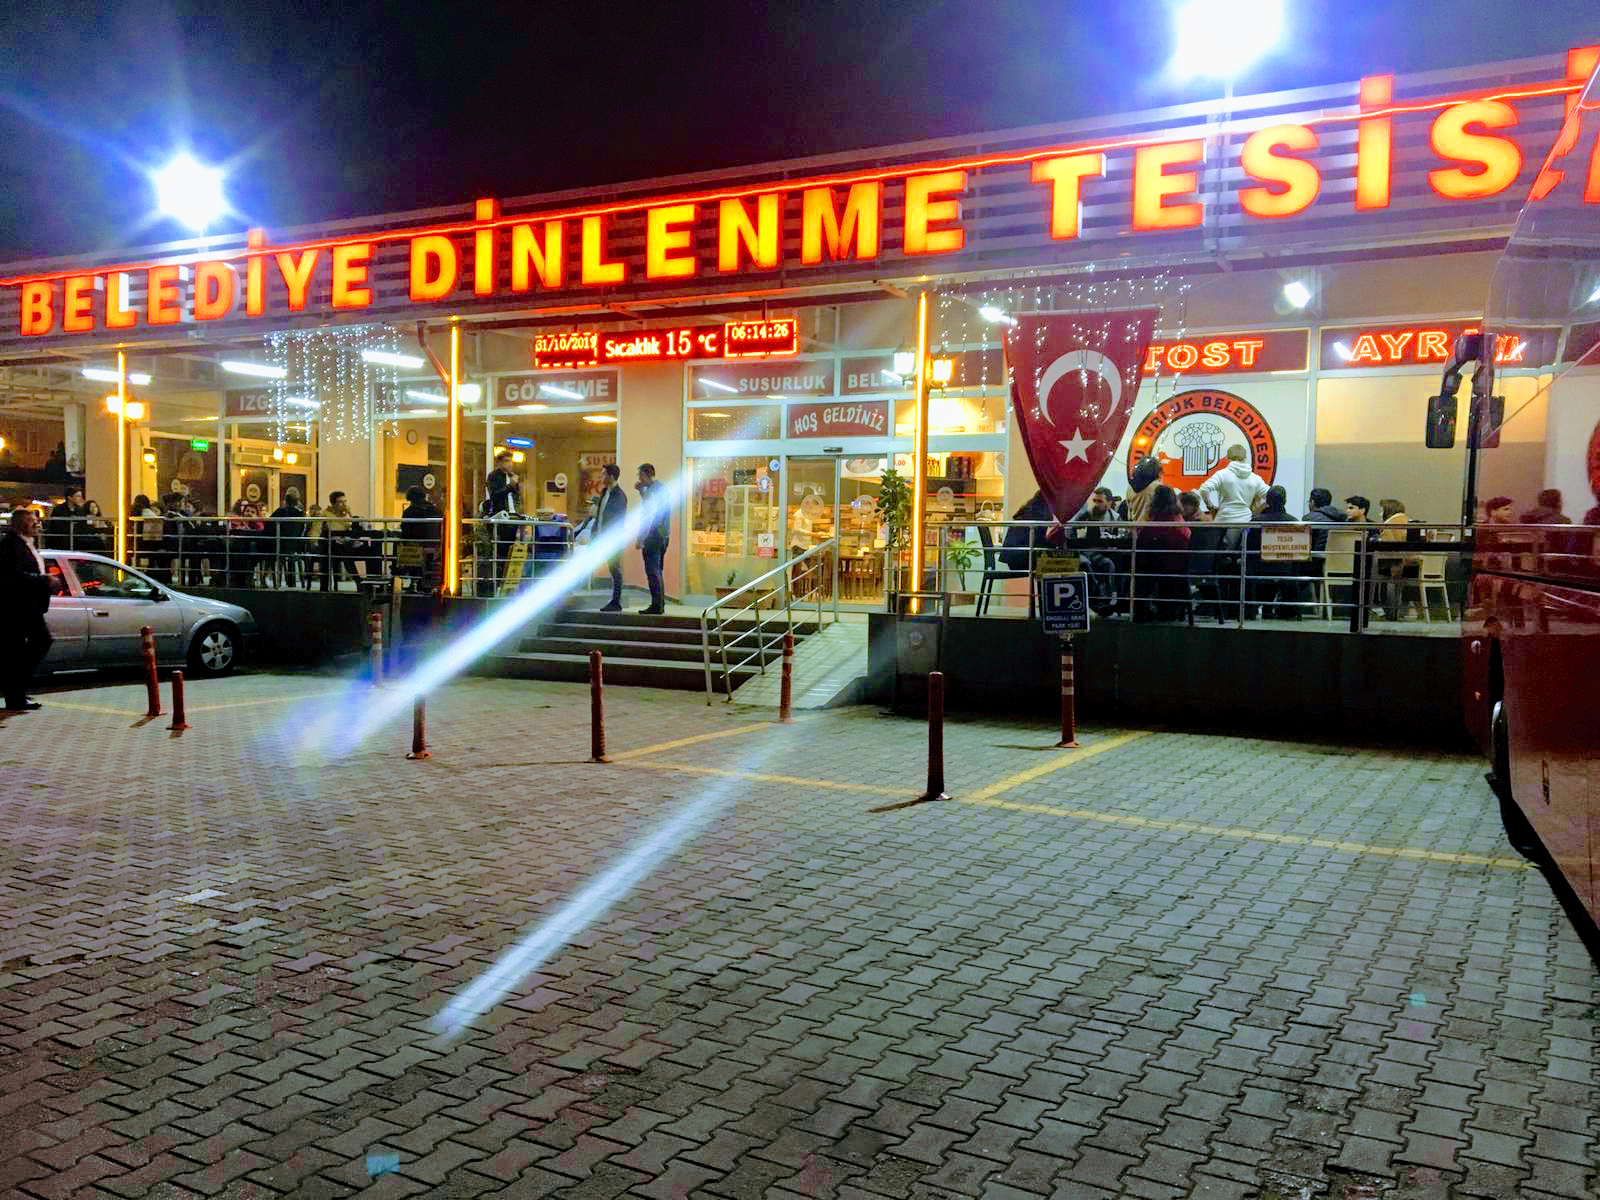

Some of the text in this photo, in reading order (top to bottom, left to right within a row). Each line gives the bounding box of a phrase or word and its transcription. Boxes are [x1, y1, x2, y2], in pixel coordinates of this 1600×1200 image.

[20, 228, 373, 336] BELEDİYE
[409, 170, 966, 301] DİNLENME
[605, 336, 659, 357] Sıcaklık
[666, 331, 691, 355] 15
[732, 324, 788, 339] 06:14:26
[1350, 329, 1479, 362] AYR
[1144, 339, 1264, 370] TOST
[739, 375, 826, 391] SUSURLUK
[794, 404, 885, 434] HOŞ GELDİNİZ
[1201, 395, 1272, 472] BELEDİYESİ
[1053, 583, 1075, 607] P
